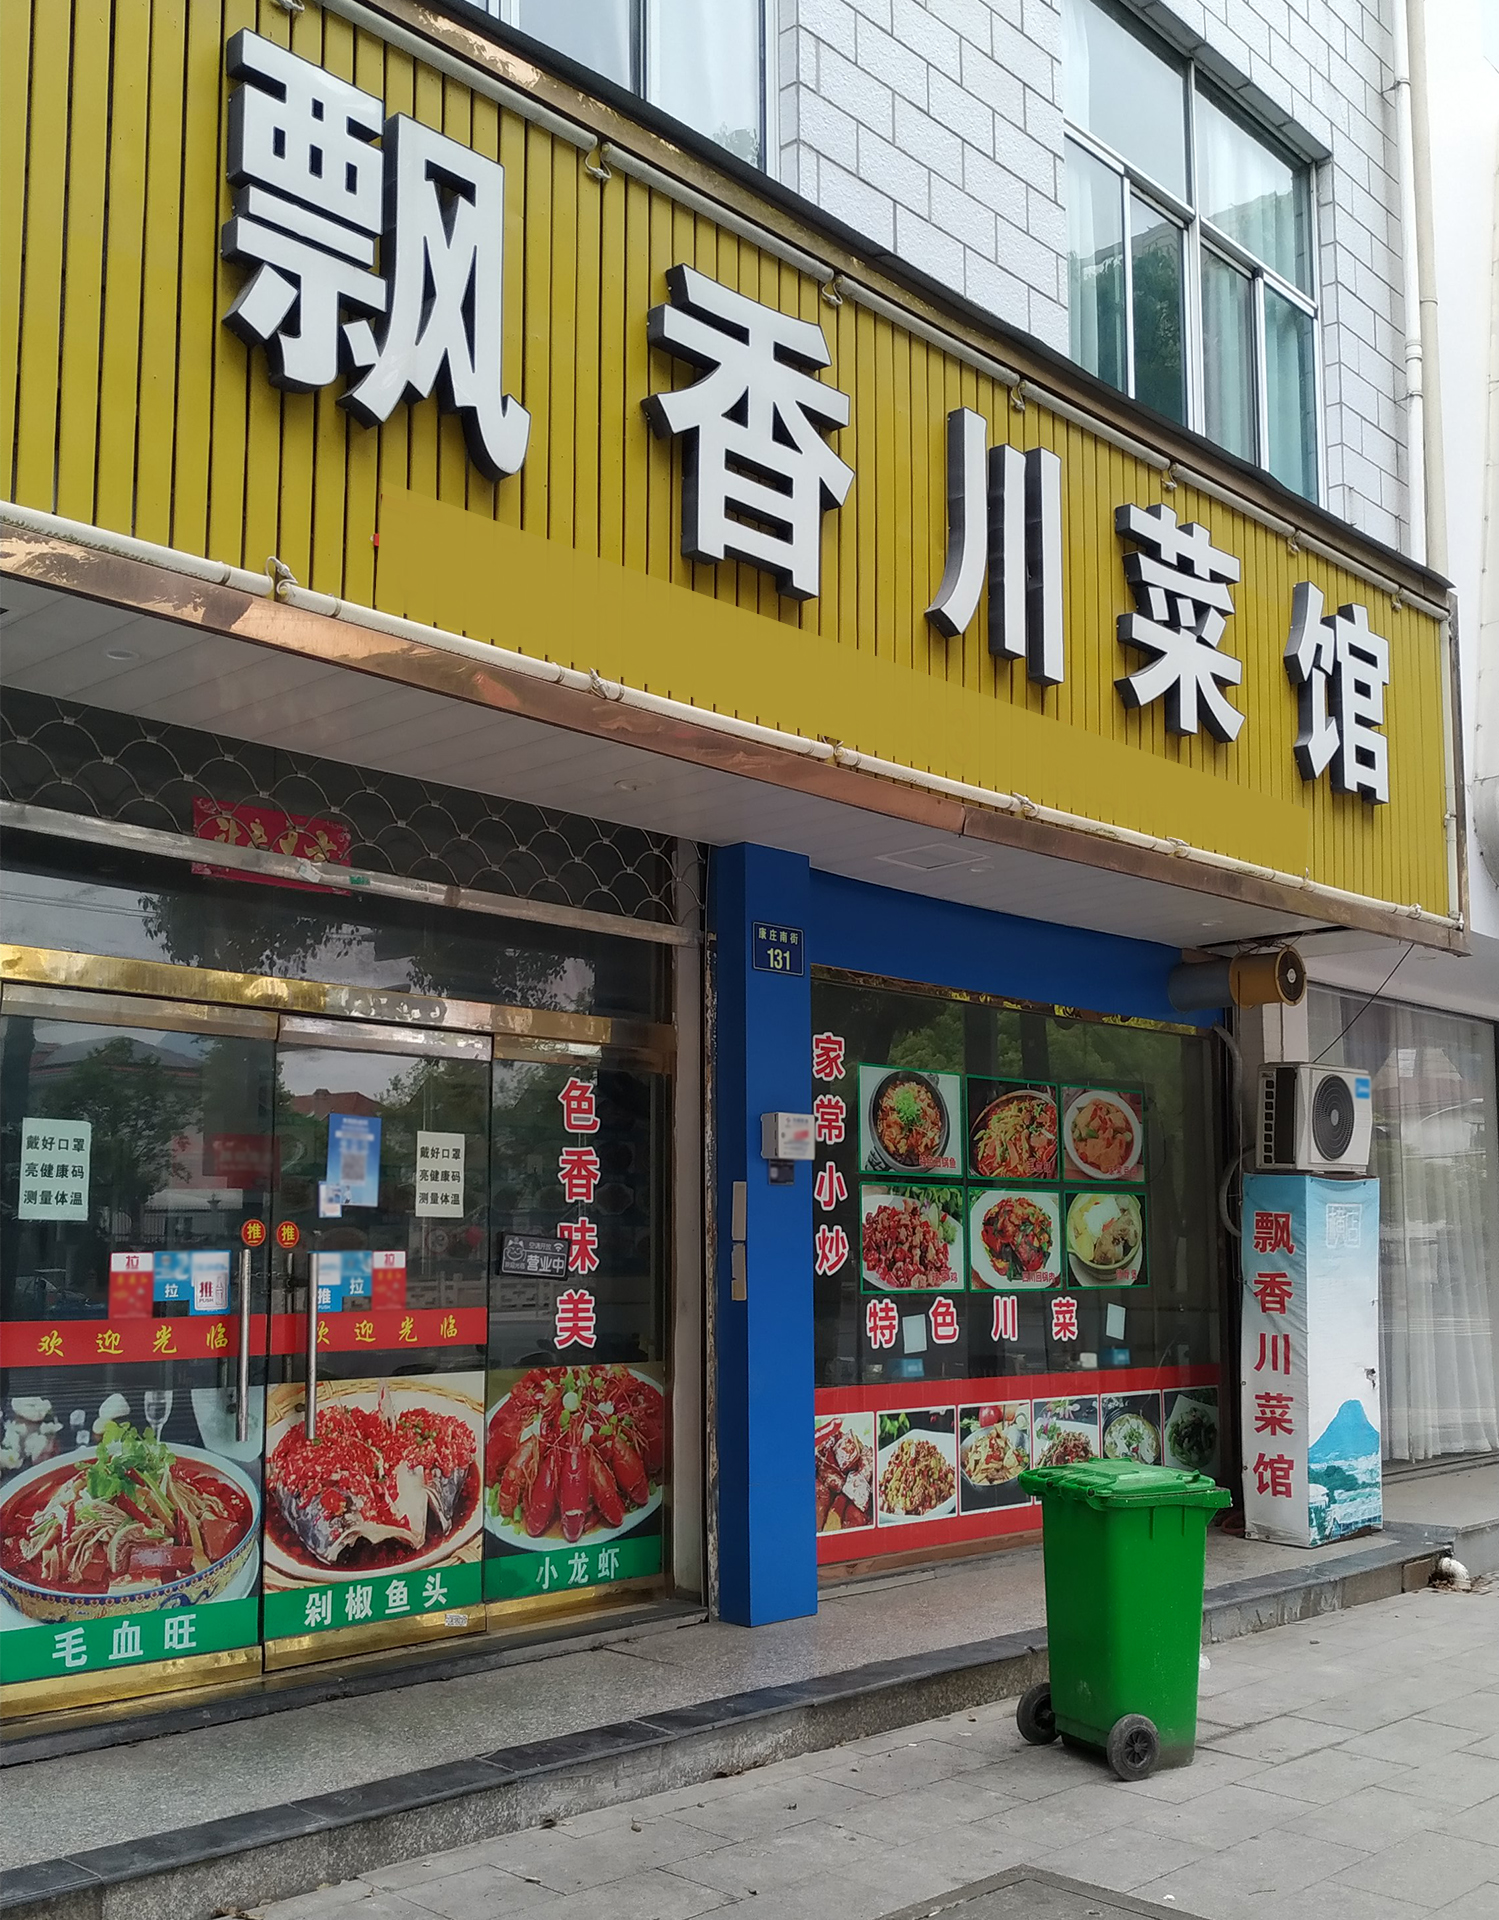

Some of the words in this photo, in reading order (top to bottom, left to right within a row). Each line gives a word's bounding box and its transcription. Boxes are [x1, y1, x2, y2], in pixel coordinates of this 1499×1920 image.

[222, 27, 1390, 806] 飘香川菜馆
[758, 927, 798, 945] 康庄南街
[767, 948, 790, 970] 131
[26, 1135, 85, 1152] 戴好口罩
[420, 1146, 461, 1160] 戴好口罩
[812, 1032, 848, 1276] 家常小炒
[25, 1162, 85, 1179] 亮健康码
[420, 1169, 461, 1183] 亮健康码
[23, 1190, 83, 1206] 测量体温
[419, 1192, 461, 1205] 测量体温
[554, 1077, 600, 1349] 色香味美
[247, 1223, 261, 1239] 推
[281, 1225, 295, 1241] 推
[125, 1255, 139, 1269] 拉
[526, 1254, 565, 1273] 营业中
[164, 1283, 179, 1299] 拉
[199, 1281, 212, 1298] 推
[350, 1277, 364, 1295] 拉
[317, 1287, 331, 1305] 推
[866, 1296, 1079, 1348] 特色川菜
[37, 1322, 228, 1357] 欢迎光临
[1253, 1211, 1295, 1498] 飘香川菜馆
[535, 1546, 620, 1589] 小龙虾
[304, 1574, 449, 1628] 剁椒鱼头
[52, 1613, 197, 1668] 毛血旺
